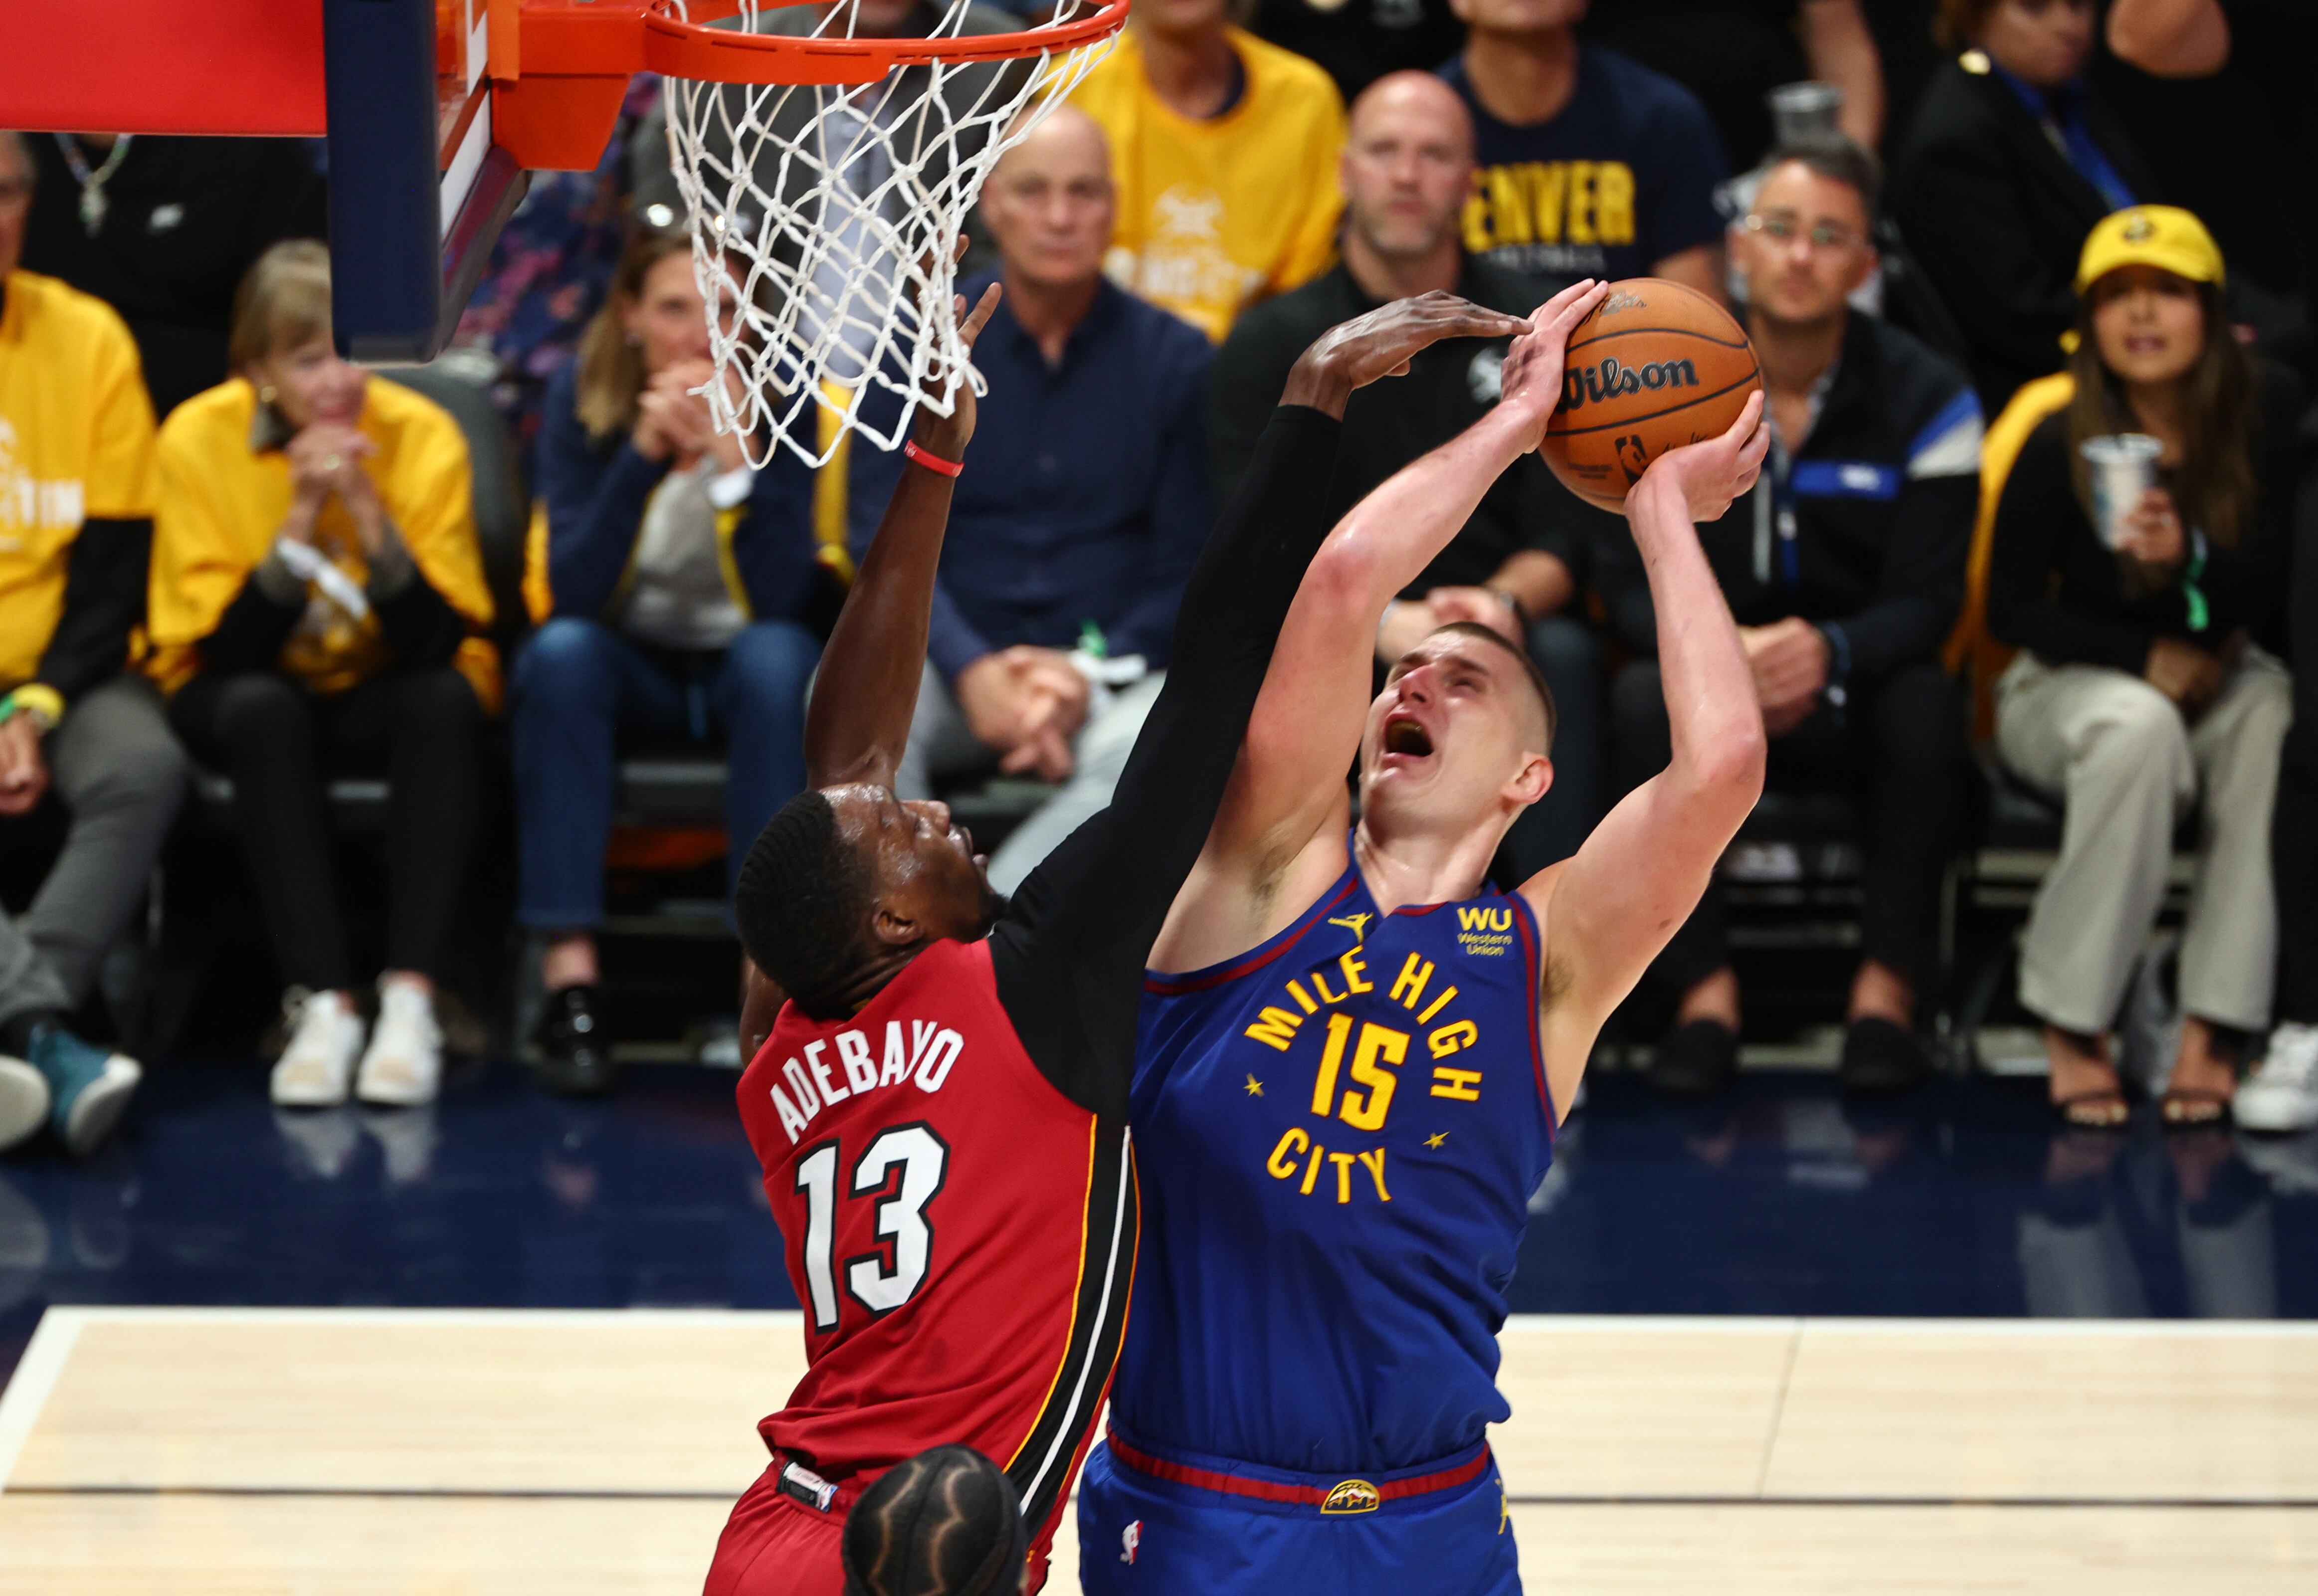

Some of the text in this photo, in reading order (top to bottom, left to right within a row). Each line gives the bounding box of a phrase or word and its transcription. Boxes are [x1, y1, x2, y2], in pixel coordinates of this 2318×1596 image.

[1462, 160, 1636, 254] ENVER
[1456, 907, 1513, 932] WU
[1457, 932, 1513, 946] Western
[1467, 944, 1504, 956] Union
[1244, 944, 1482, 1101] MILE HIGH
[770, 1019, 964, 1145] ADEBAYO
[1311, 1011, 1411, 1131] 15
[1266, 1127, 1392, 1203] CITY
[794, 1120, 950, 1335] 13
